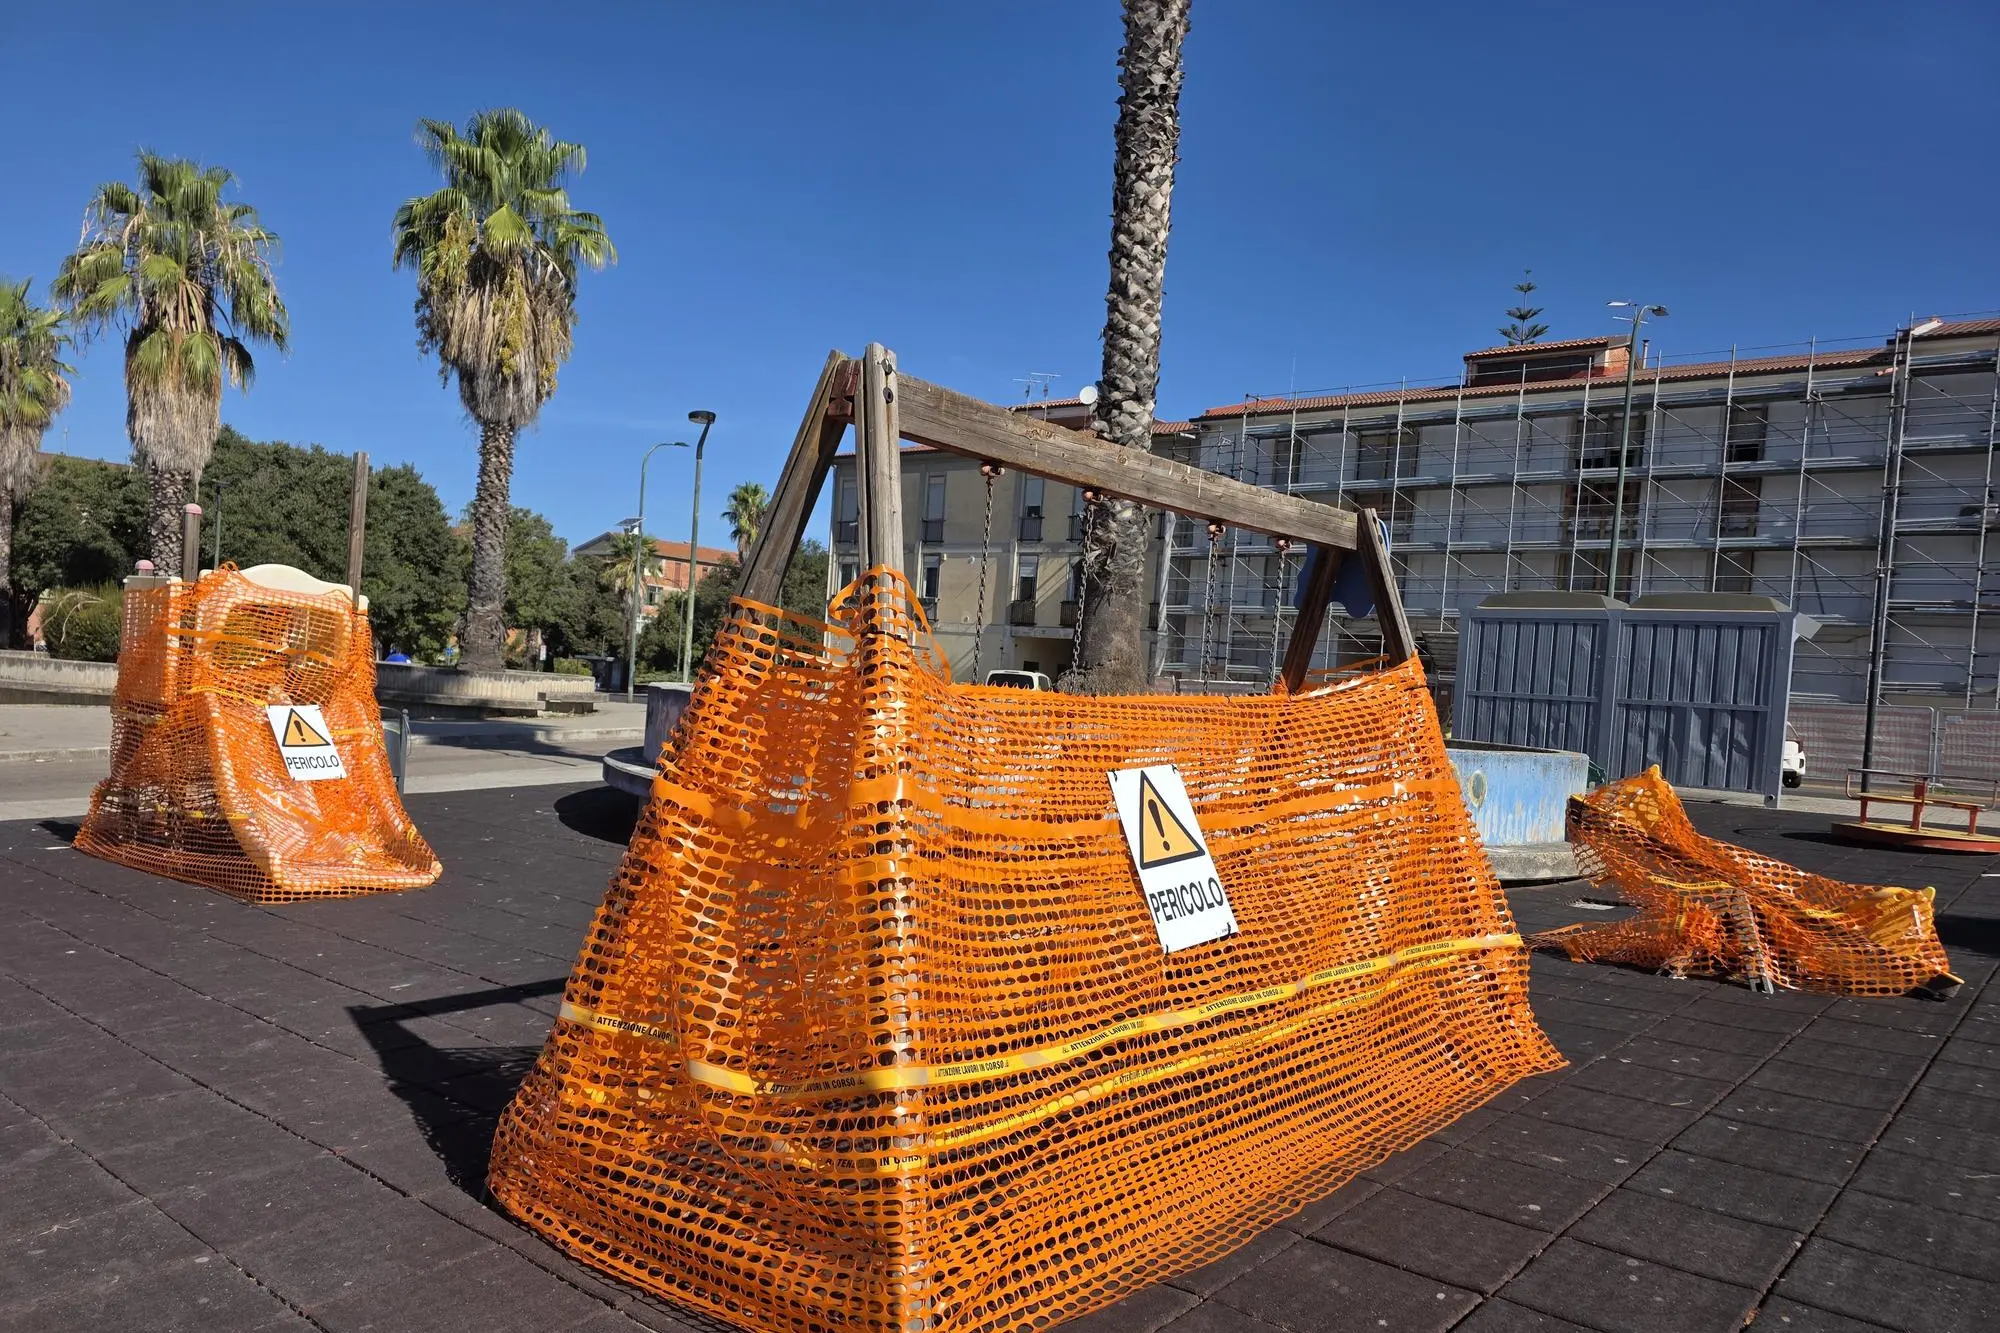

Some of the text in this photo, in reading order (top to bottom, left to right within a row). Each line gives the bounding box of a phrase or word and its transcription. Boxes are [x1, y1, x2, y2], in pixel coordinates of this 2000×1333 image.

[285, 754, 340, 770] PERICOLO
[1148, 876, 1224, 924] PERICOLO
[1333, 967, 1349, 976] LAVORI
[1355, 961, 1372, 971] CORSO
[1205, 997, 1239, 1012] ATTENZIONE
[1238, 994, 1255, 1004] LAVORI
[1262, 988, 1279, 998] CORSO
[596, 1016, 648, 1035] ATTENZIONE
[1070, 1031, 1110, 1051] ATTENZIONE
[1109, 1023, 1130, 1035] LAVORI
[961, 1063, 980, 1075] LAVORI
[979, 1063, 986, 1072] IN
[985, 1059, 1004, 1071] CORSO
[823, 1080, 831, 1090] IN
[831, 1077, 856, 1090] CORSO
[880, 1156, 890, 1167] IN
